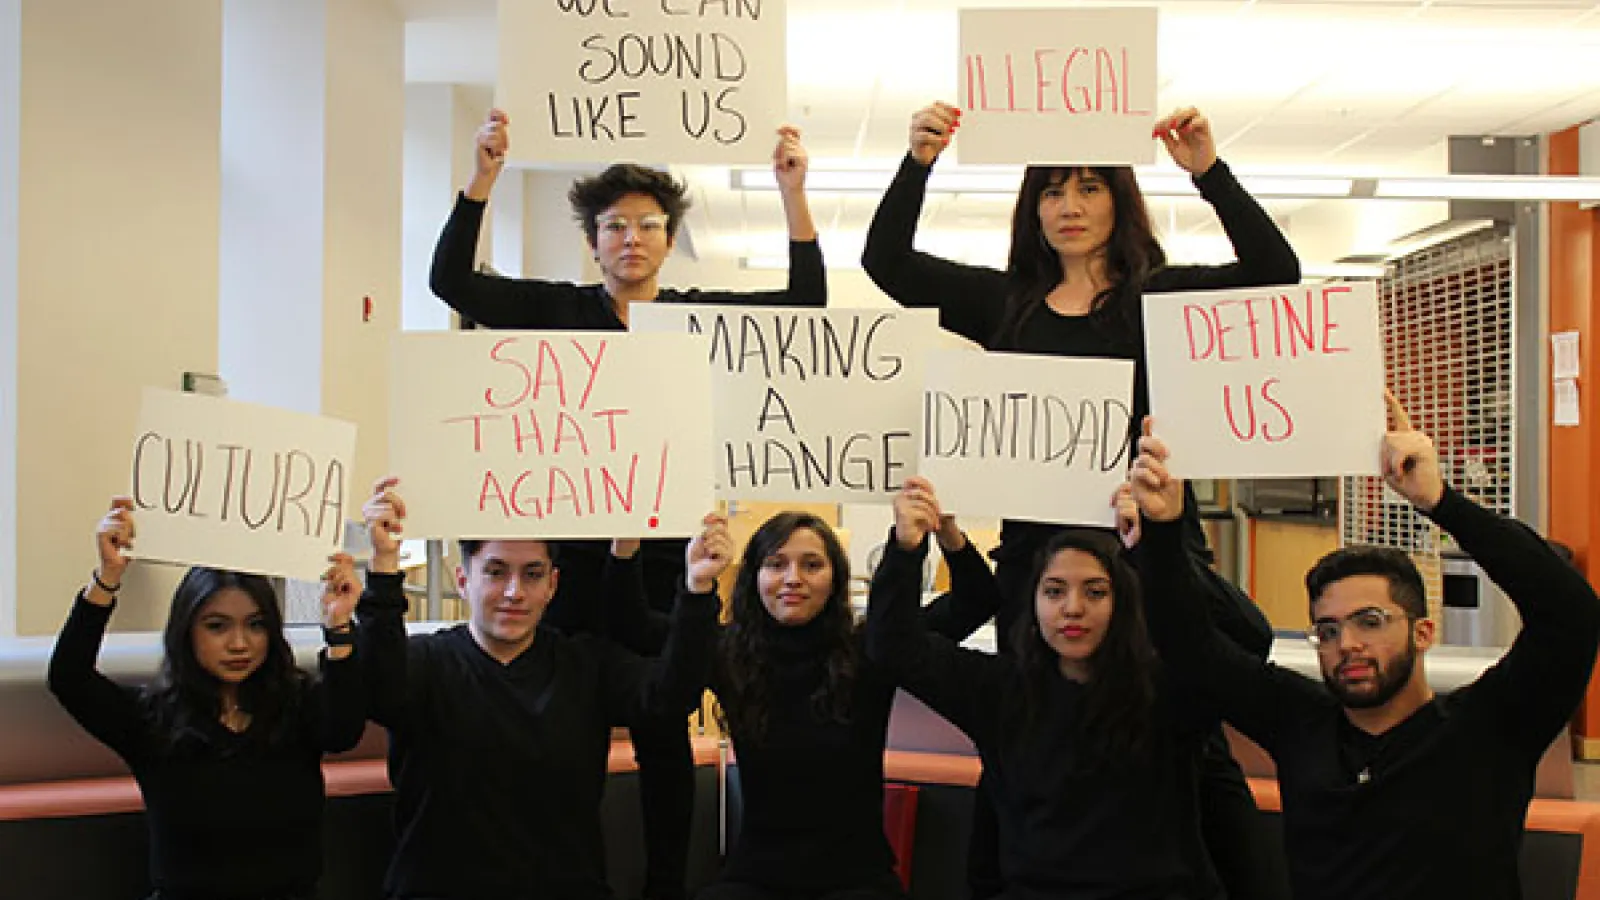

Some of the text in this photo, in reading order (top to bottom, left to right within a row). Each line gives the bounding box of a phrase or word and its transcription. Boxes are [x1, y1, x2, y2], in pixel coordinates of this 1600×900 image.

[579, 33, 746, 84] SOUND
[966, 46, 1151, 116] ILLEGAL
[549, 87, 747, 144] LIKE US
[688, 313, 902, 381] MAKING
[1183, 287, 1352, 361] DEFINE
[485, 337, 607, 410] SAY
[443, 408, 630, 455] THAT
[757, 386, 796, 434] A
[925, 391, 1132, 471] IDENTIDAD
[1223, 377, 1294, 441] US
[133, 431, 343, 546] CULTURA
[479, 439, 668, 528] AGAIN!
[714, 430, 912, 492] HANGE
